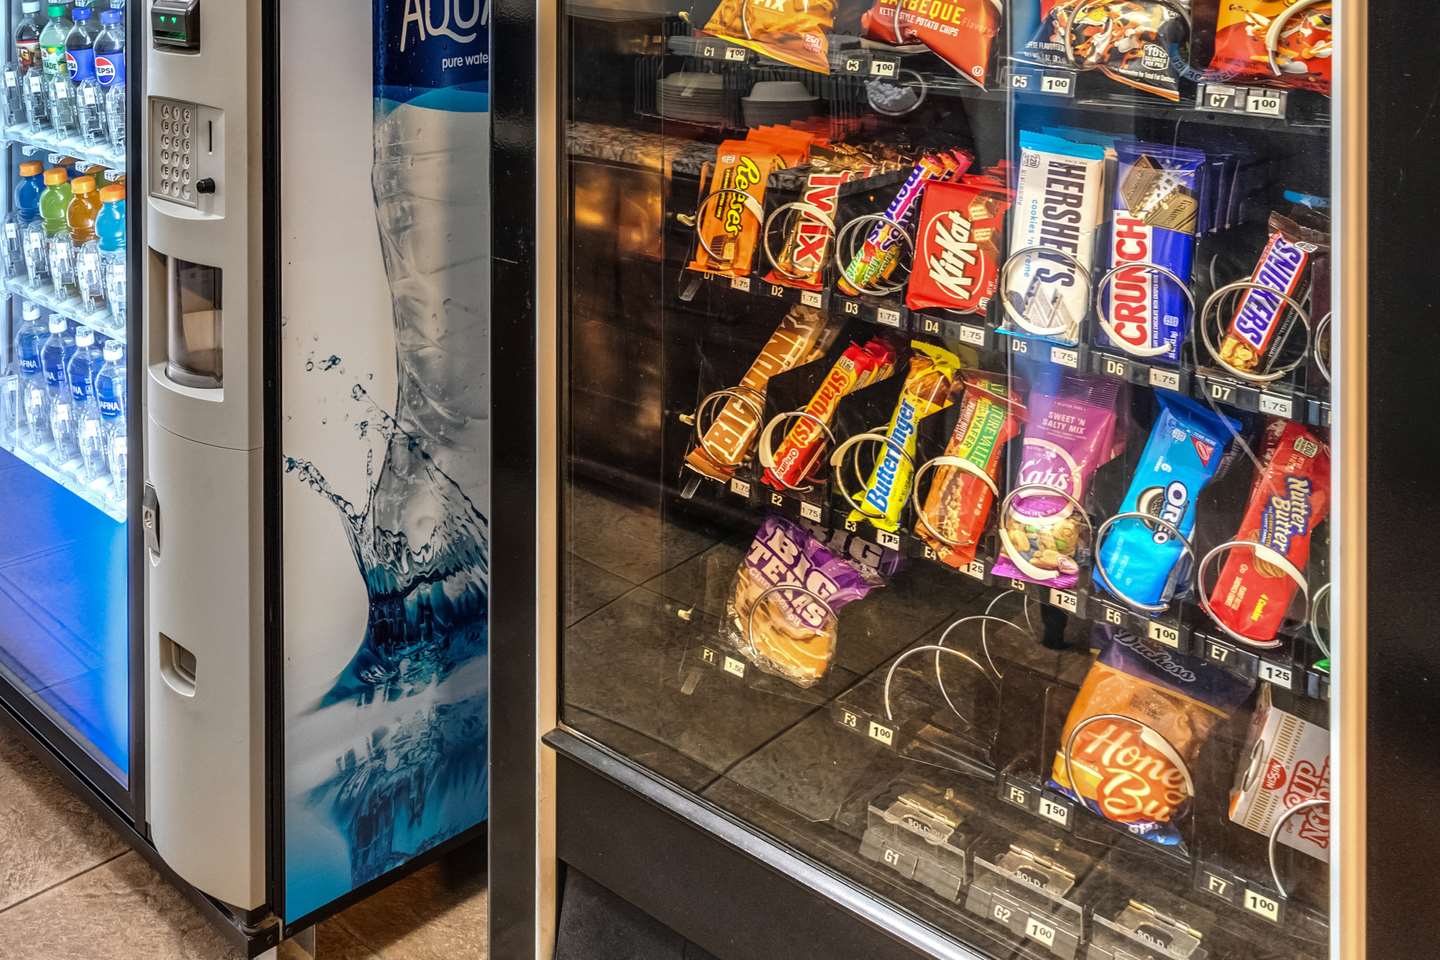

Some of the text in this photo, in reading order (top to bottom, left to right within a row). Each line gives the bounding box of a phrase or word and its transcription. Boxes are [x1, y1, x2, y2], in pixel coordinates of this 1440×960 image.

[915, 17, 939, 31] POTATO
[704, 47, 715, 57] C1
[442, 55, 463, 72] pure
[1012, 76, 1028, 87] C5
[1210, 95, 1229, 107] C7
[793, 171, 852, 263] TWIX
[1038, 160, 1087, 287] HERSHEY'S
[1023, 199, 1038, 278] cookies reme
[929, 211, 977, 300] KitKat
[1114, 218, 1148, 346] CRUNCH
[772, 285, 783, 297] D2
[1237, 238, 1302, 347] SNICKERS
[845, 302, 858, 314] D3
[925, 320, 939, 333] D4
[1012, 340, 1027, 352] D5
[1107, 361, 1124, 375] D6
[1212, 386, 1231, 400] D7
[1048, 412, 1075, 425] SWEET
[966, 415, 983, 448] WAFER
[1042, 419, 1086, 434] SALTY MIX
[772, 494, 783, 507] E2
[1287, 477, 1309, 535] Nutter
[846, 521, 857, 532] E3
[1272, 496, 1288, 553] Butter
[766, 528, 838, 601] BIG
[747, 540, 828, 627] TEXAS
[1106, 610, 1121, 625] E6
[703, 649, 714, 661] F1
[1211, 646, 1228, 662] E7
[843, 712, 857, 728] F3
[1266, 764, 1283, 789] NISSIN
[1010, 788, 1025, 803] F5
[884, 850, 899, 865] G1
[1016, 870, 1041, 887] SOLD
[1209, 876, 1226, 894] F7
[994, 905, 1012, 922] G2
